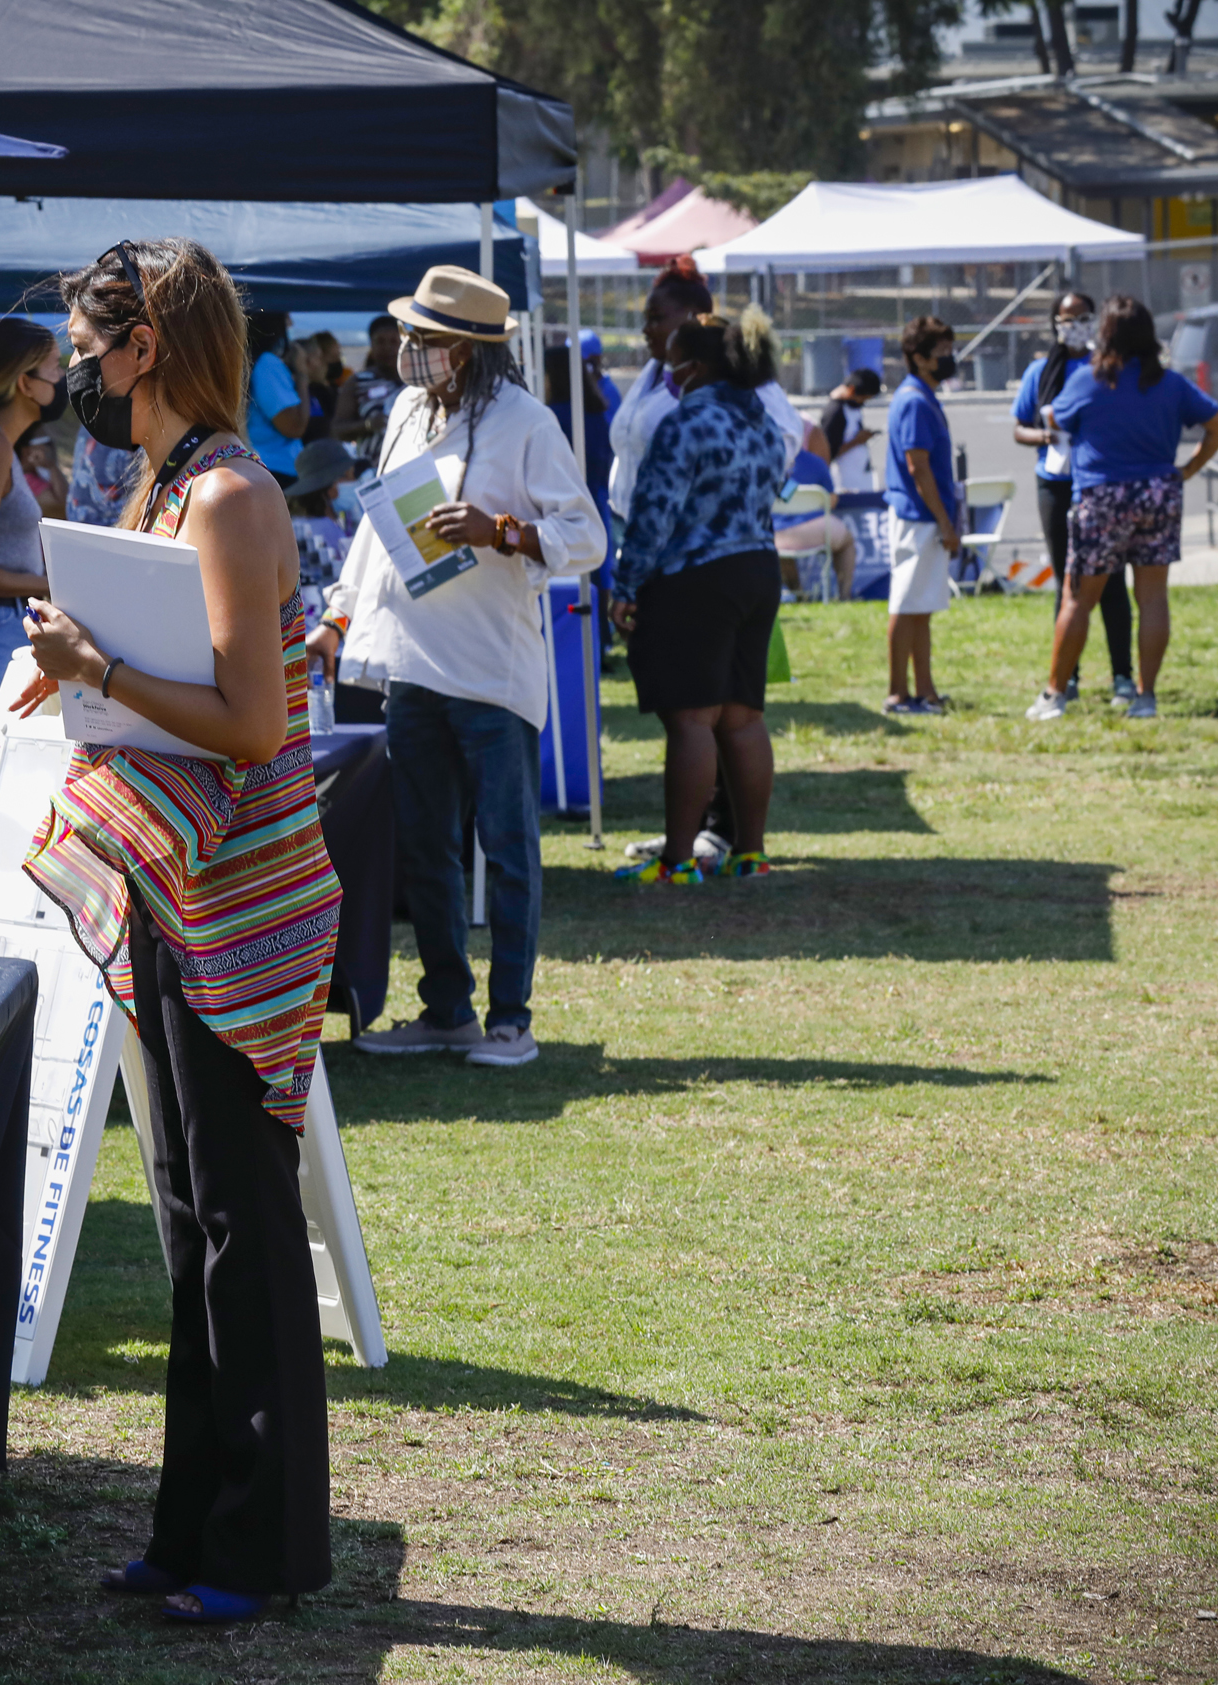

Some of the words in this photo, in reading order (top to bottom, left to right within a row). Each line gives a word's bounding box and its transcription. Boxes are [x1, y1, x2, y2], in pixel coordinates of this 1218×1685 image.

[67, 1000, 104, 1116] COSAS
[54, 1126, 76, 1172] DE
[18, 1182, 63, 1325] FITNESS
